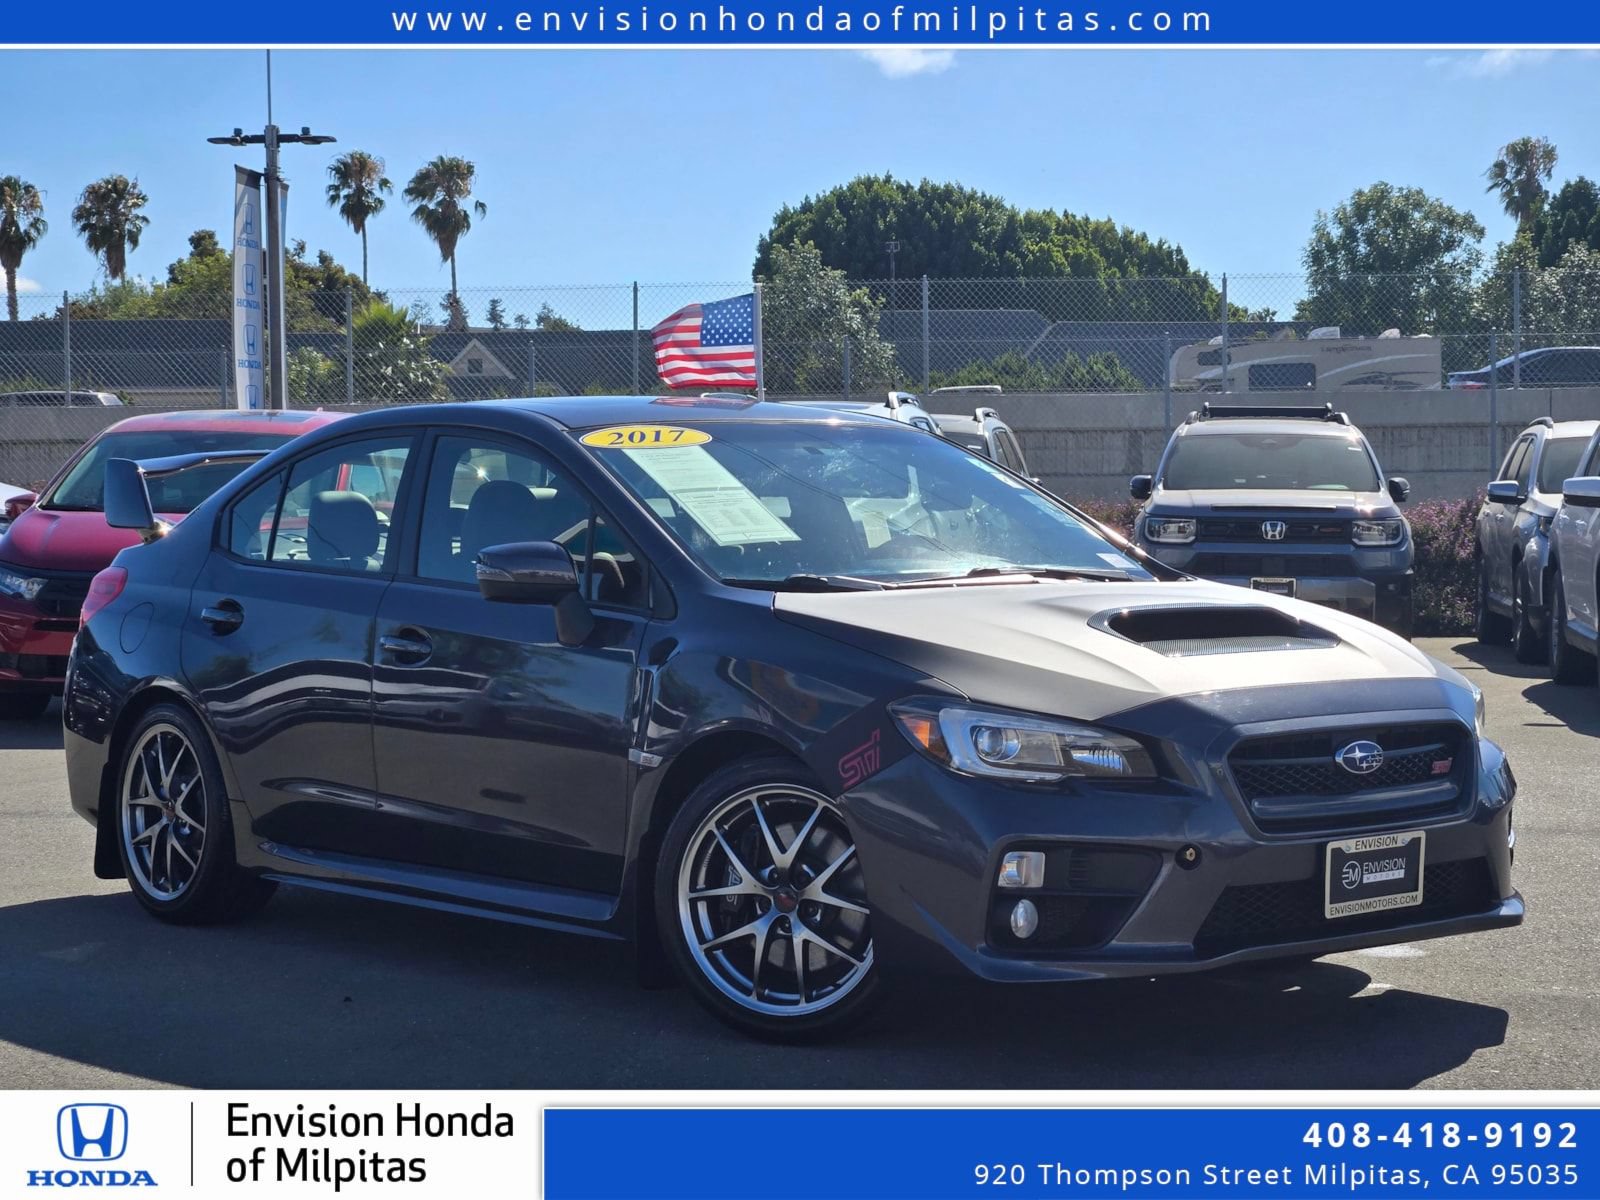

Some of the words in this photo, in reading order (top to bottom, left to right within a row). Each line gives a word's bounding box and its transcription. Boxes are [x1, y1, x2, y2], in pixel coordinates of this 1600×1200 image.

[237, 237, 259, 250] HONDA
[236, 298, 261, 310] HONDA
[237, 358, 262, 370] HONDA
[607, 429, 686, 446] 2017
[1354, 836, 1399, 851] ENVISION
[1363, 857, 1406, 874] ENVISION
[1366, 872, 1402, 882] MOTORS
[1329, 894, 1418, 917] ENVISIONMOTORS.COM
